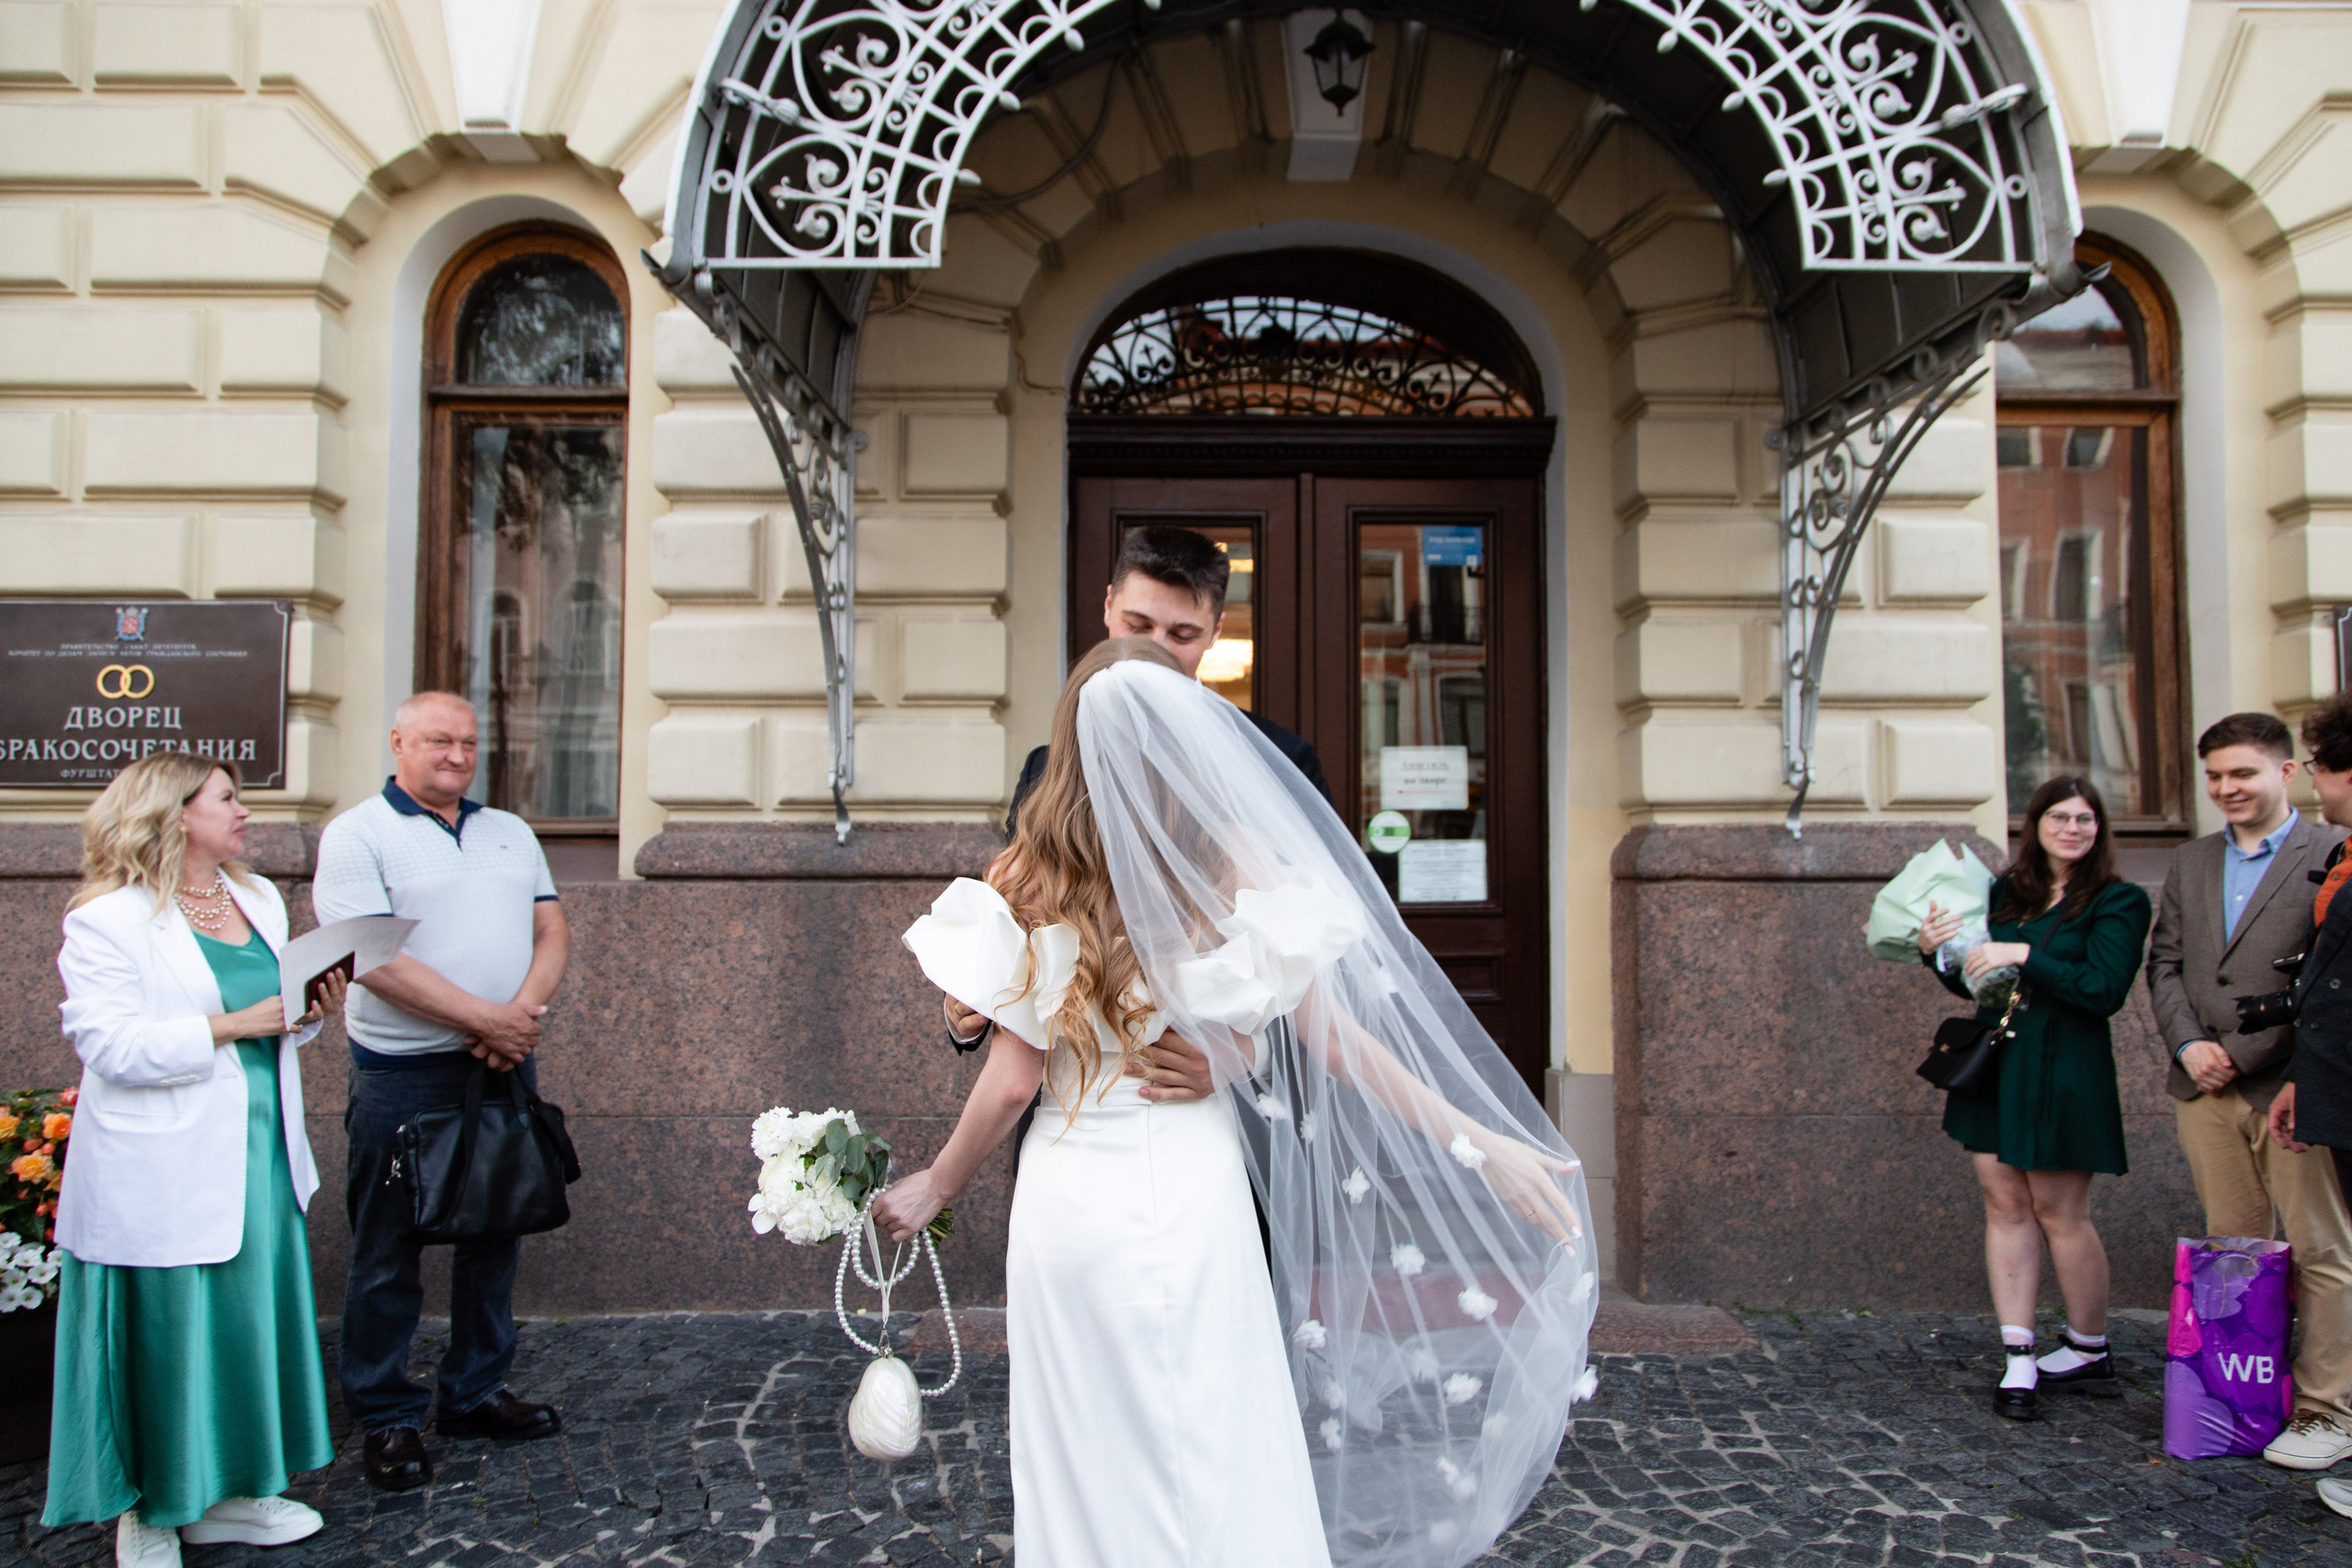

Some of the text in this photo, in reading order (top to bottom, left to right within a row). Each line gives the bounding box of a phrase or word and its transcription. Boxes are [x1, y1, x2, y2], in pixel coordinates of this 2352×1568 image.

[62, 706, 183, 730] ДВОРЕЦ
[60, 769, 121, 778] ФУРШТАТ
[2217, 1352, 2274, 1383] WB
